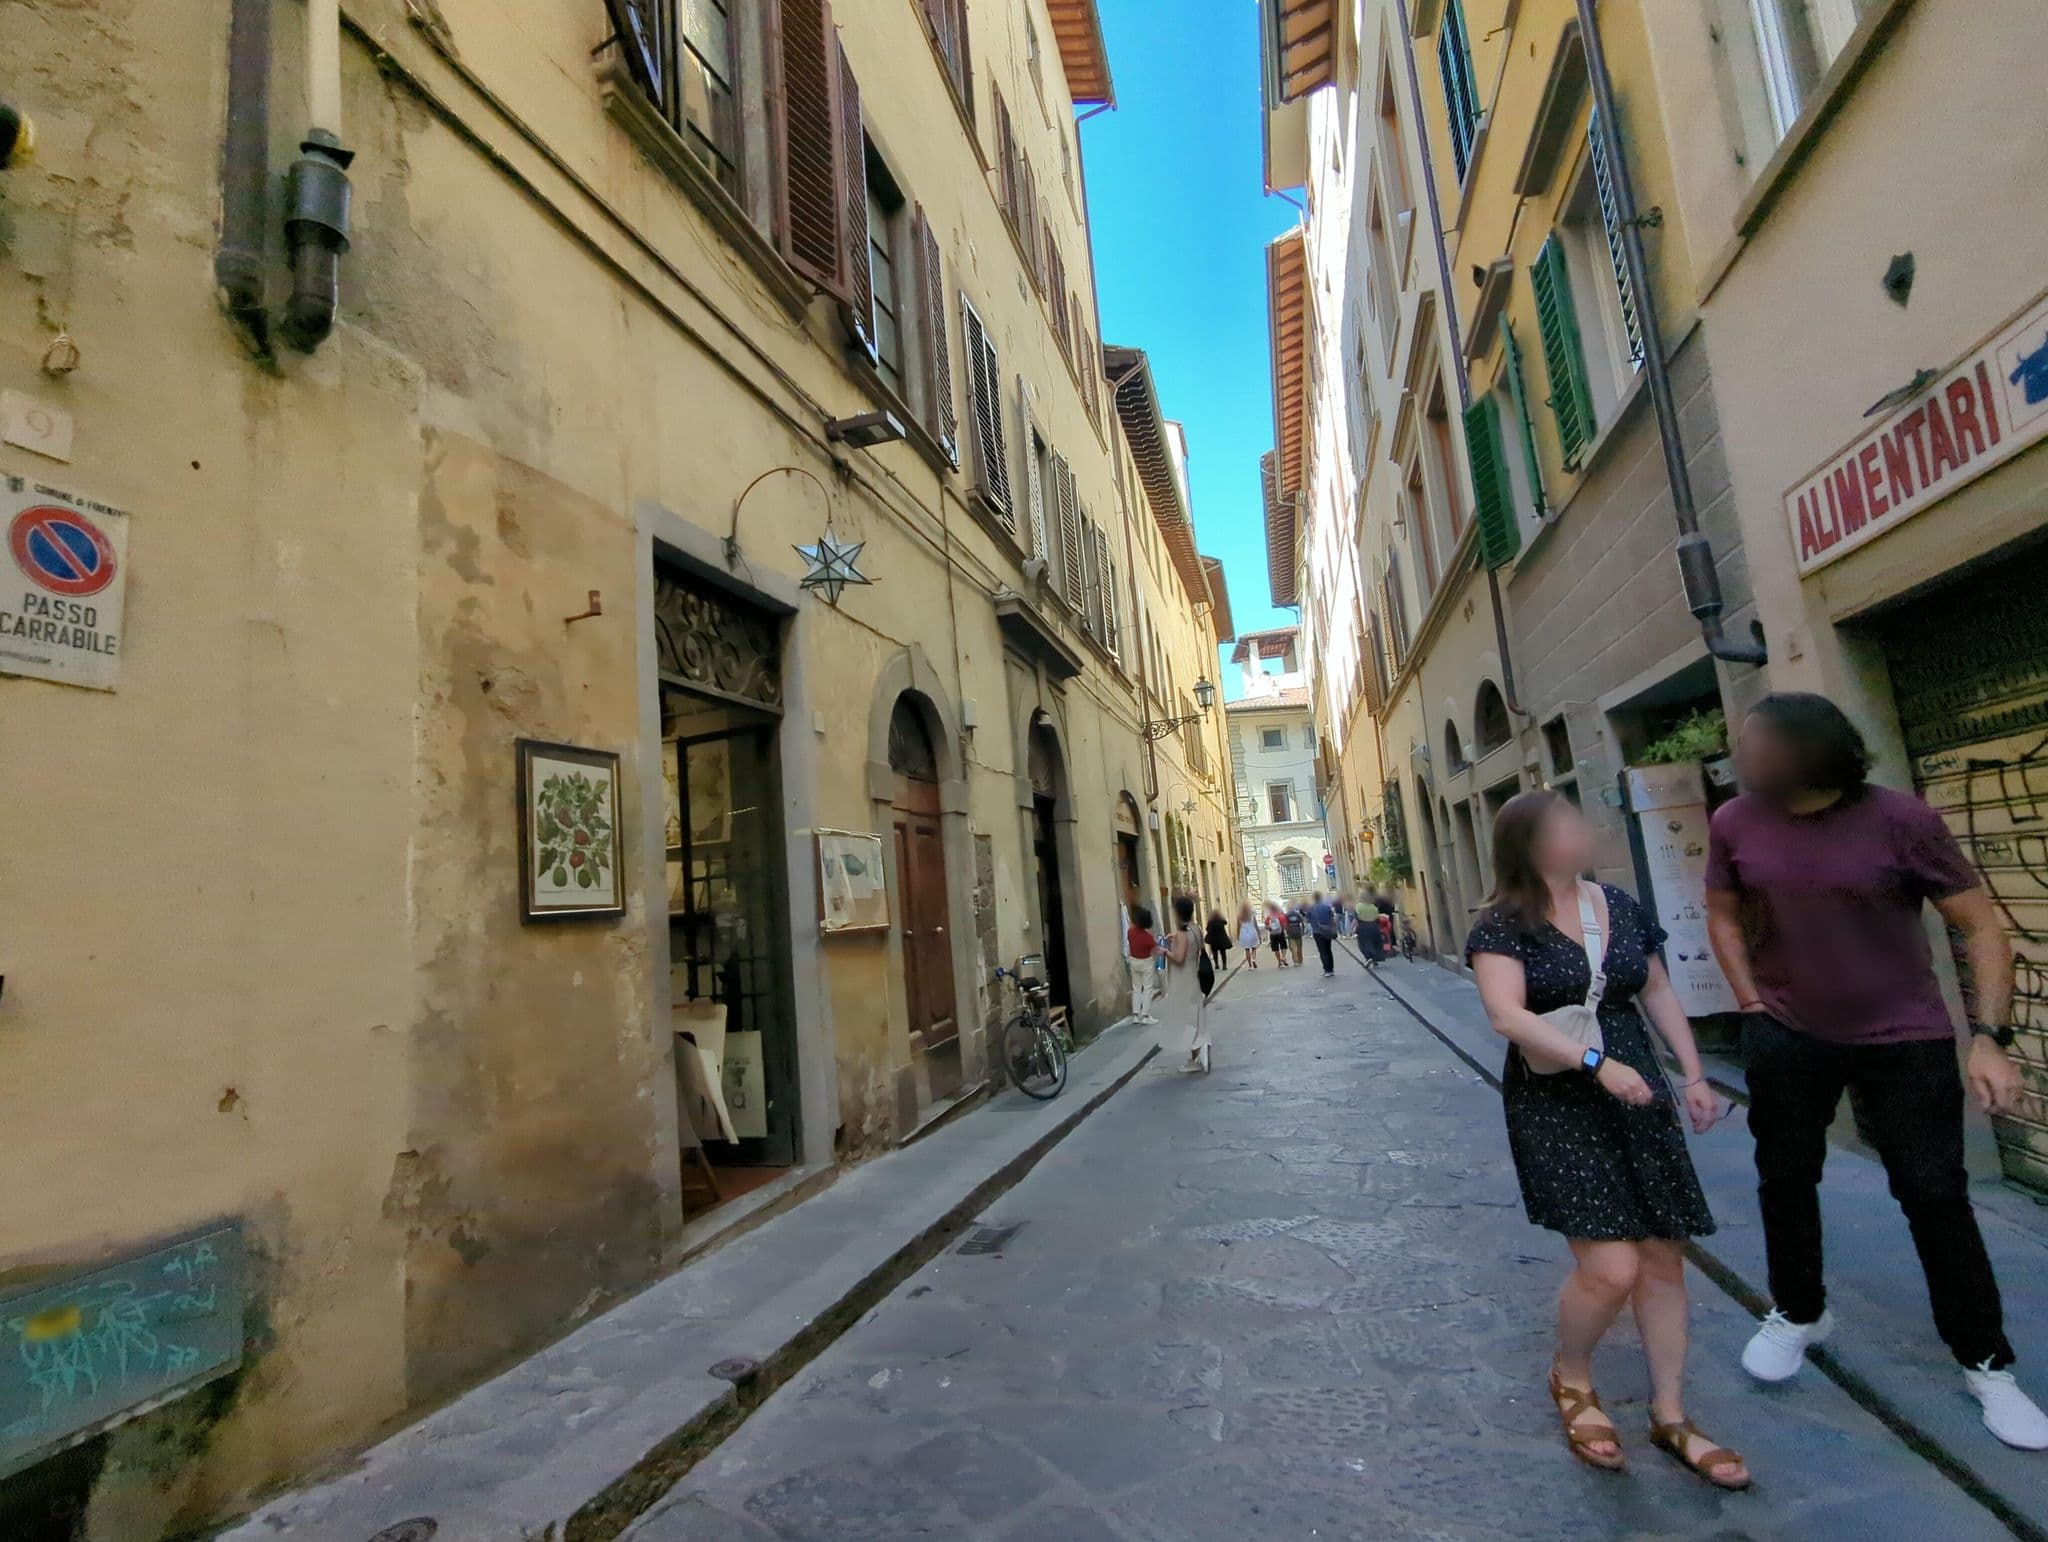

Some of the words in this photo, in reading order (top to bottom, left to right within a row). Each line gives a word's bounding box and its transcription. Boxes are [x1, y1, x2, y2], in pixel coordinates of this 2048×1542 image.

[1797, 360, 2000, 562] ALIMENTARI
[34, 483, 74, 504] COMUNE
[24, 592, 96, 628] PASSO
[0, 611, 116, 656] CARRABILE
